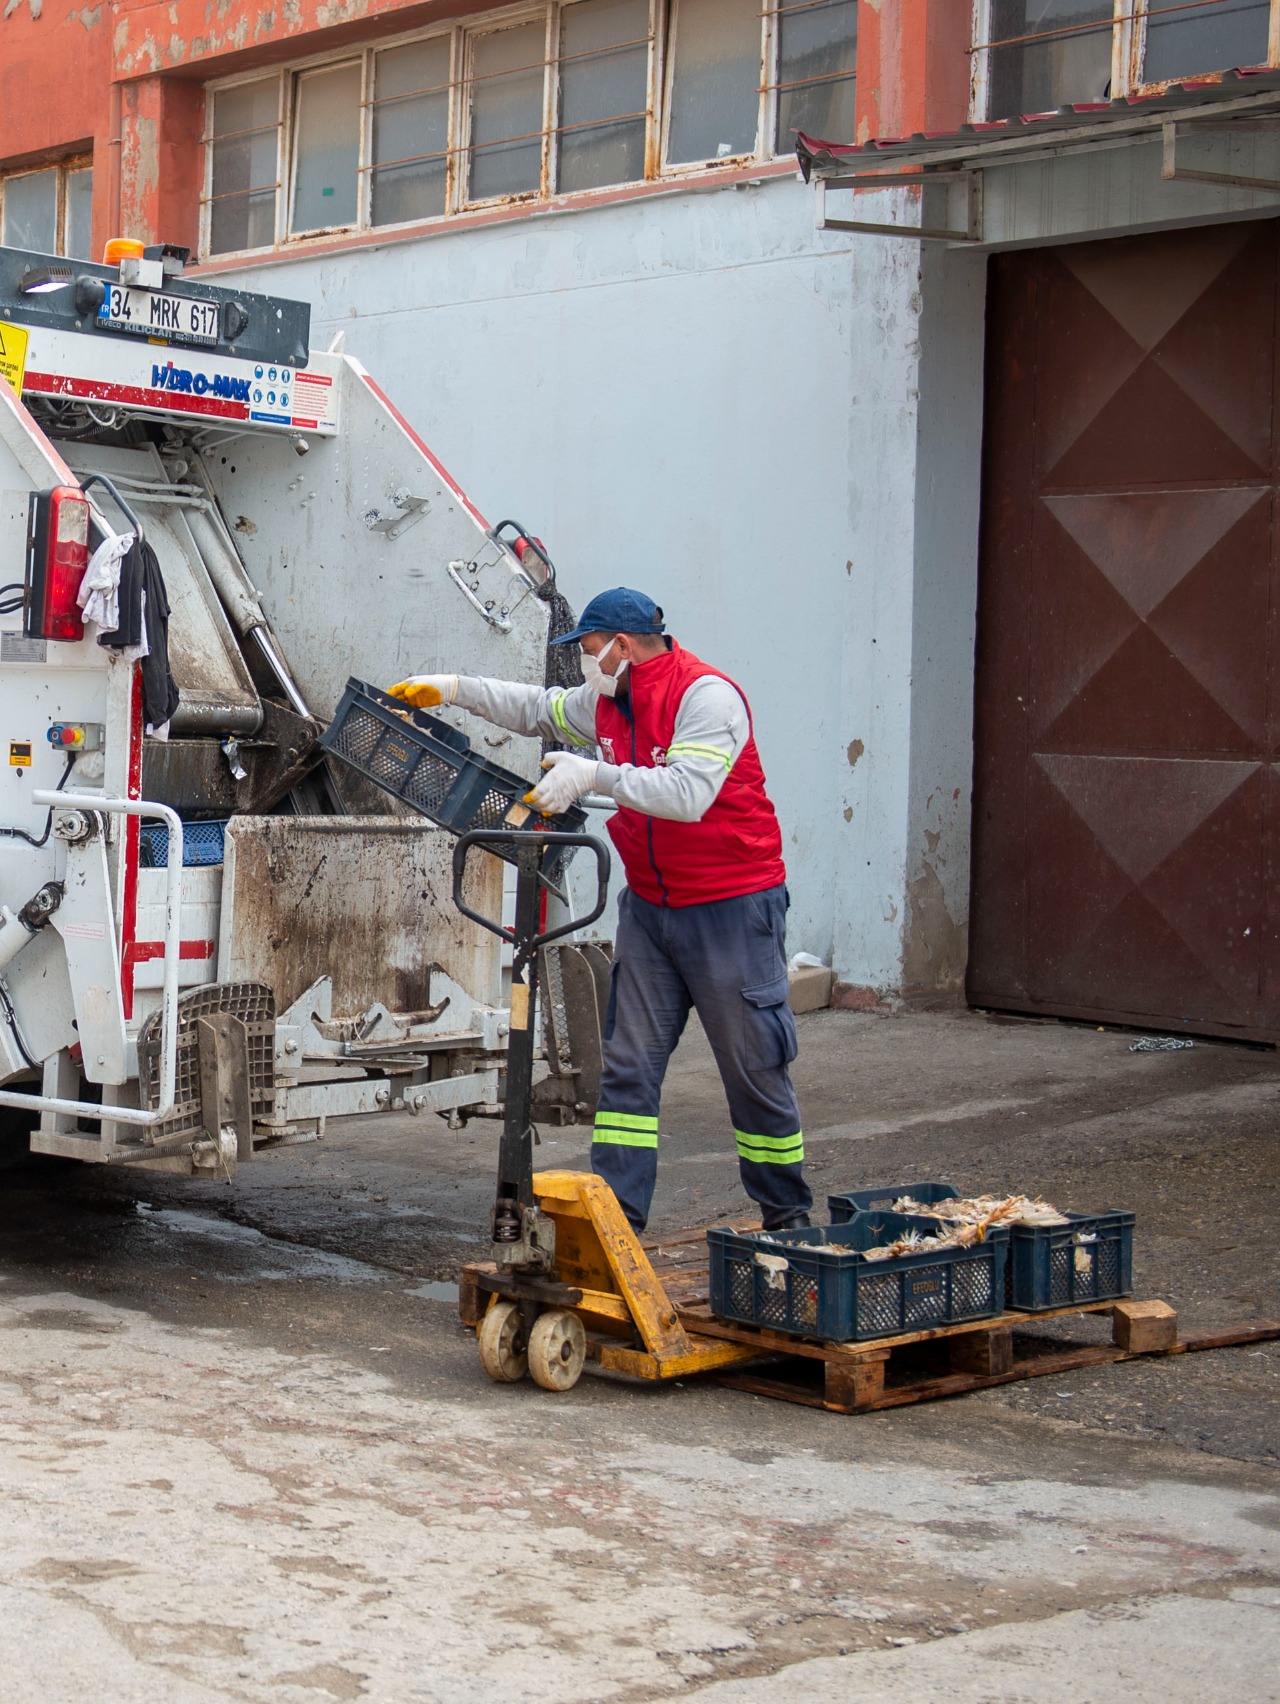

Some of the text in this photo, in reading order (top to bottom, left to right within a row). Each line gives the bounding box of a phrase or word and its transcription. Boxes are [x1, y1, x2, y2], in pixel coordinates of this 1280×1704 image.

[110, 289, 216, 335] 34 MRK 617
